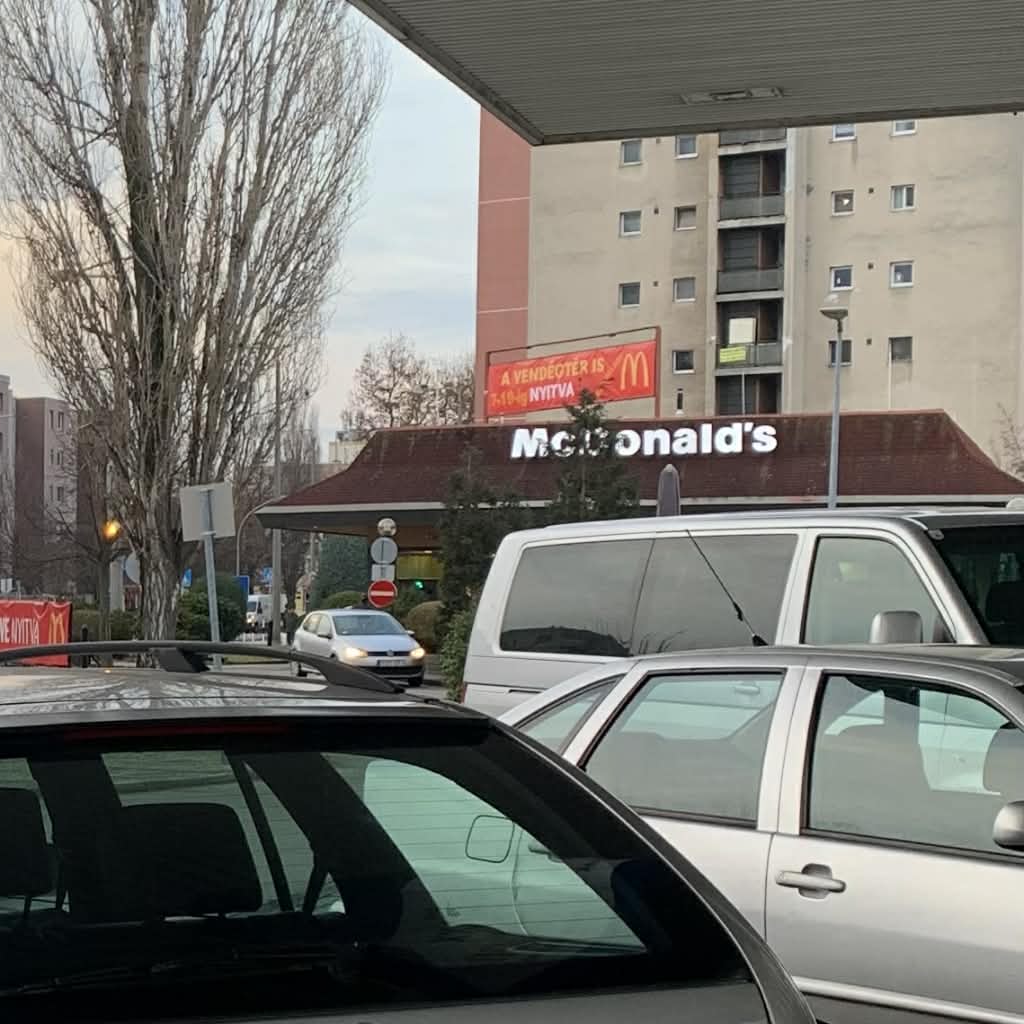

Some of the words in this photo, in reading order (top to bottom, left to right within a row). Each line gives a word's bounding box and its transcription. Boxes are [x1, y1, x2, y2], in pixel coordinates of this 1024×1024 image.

[501, 370, 510, 386] A
[592, 357, 605, 373] IS
[529, 382, 575, 402] NYITVA
[11, 617, 40, 646] NYITVA
